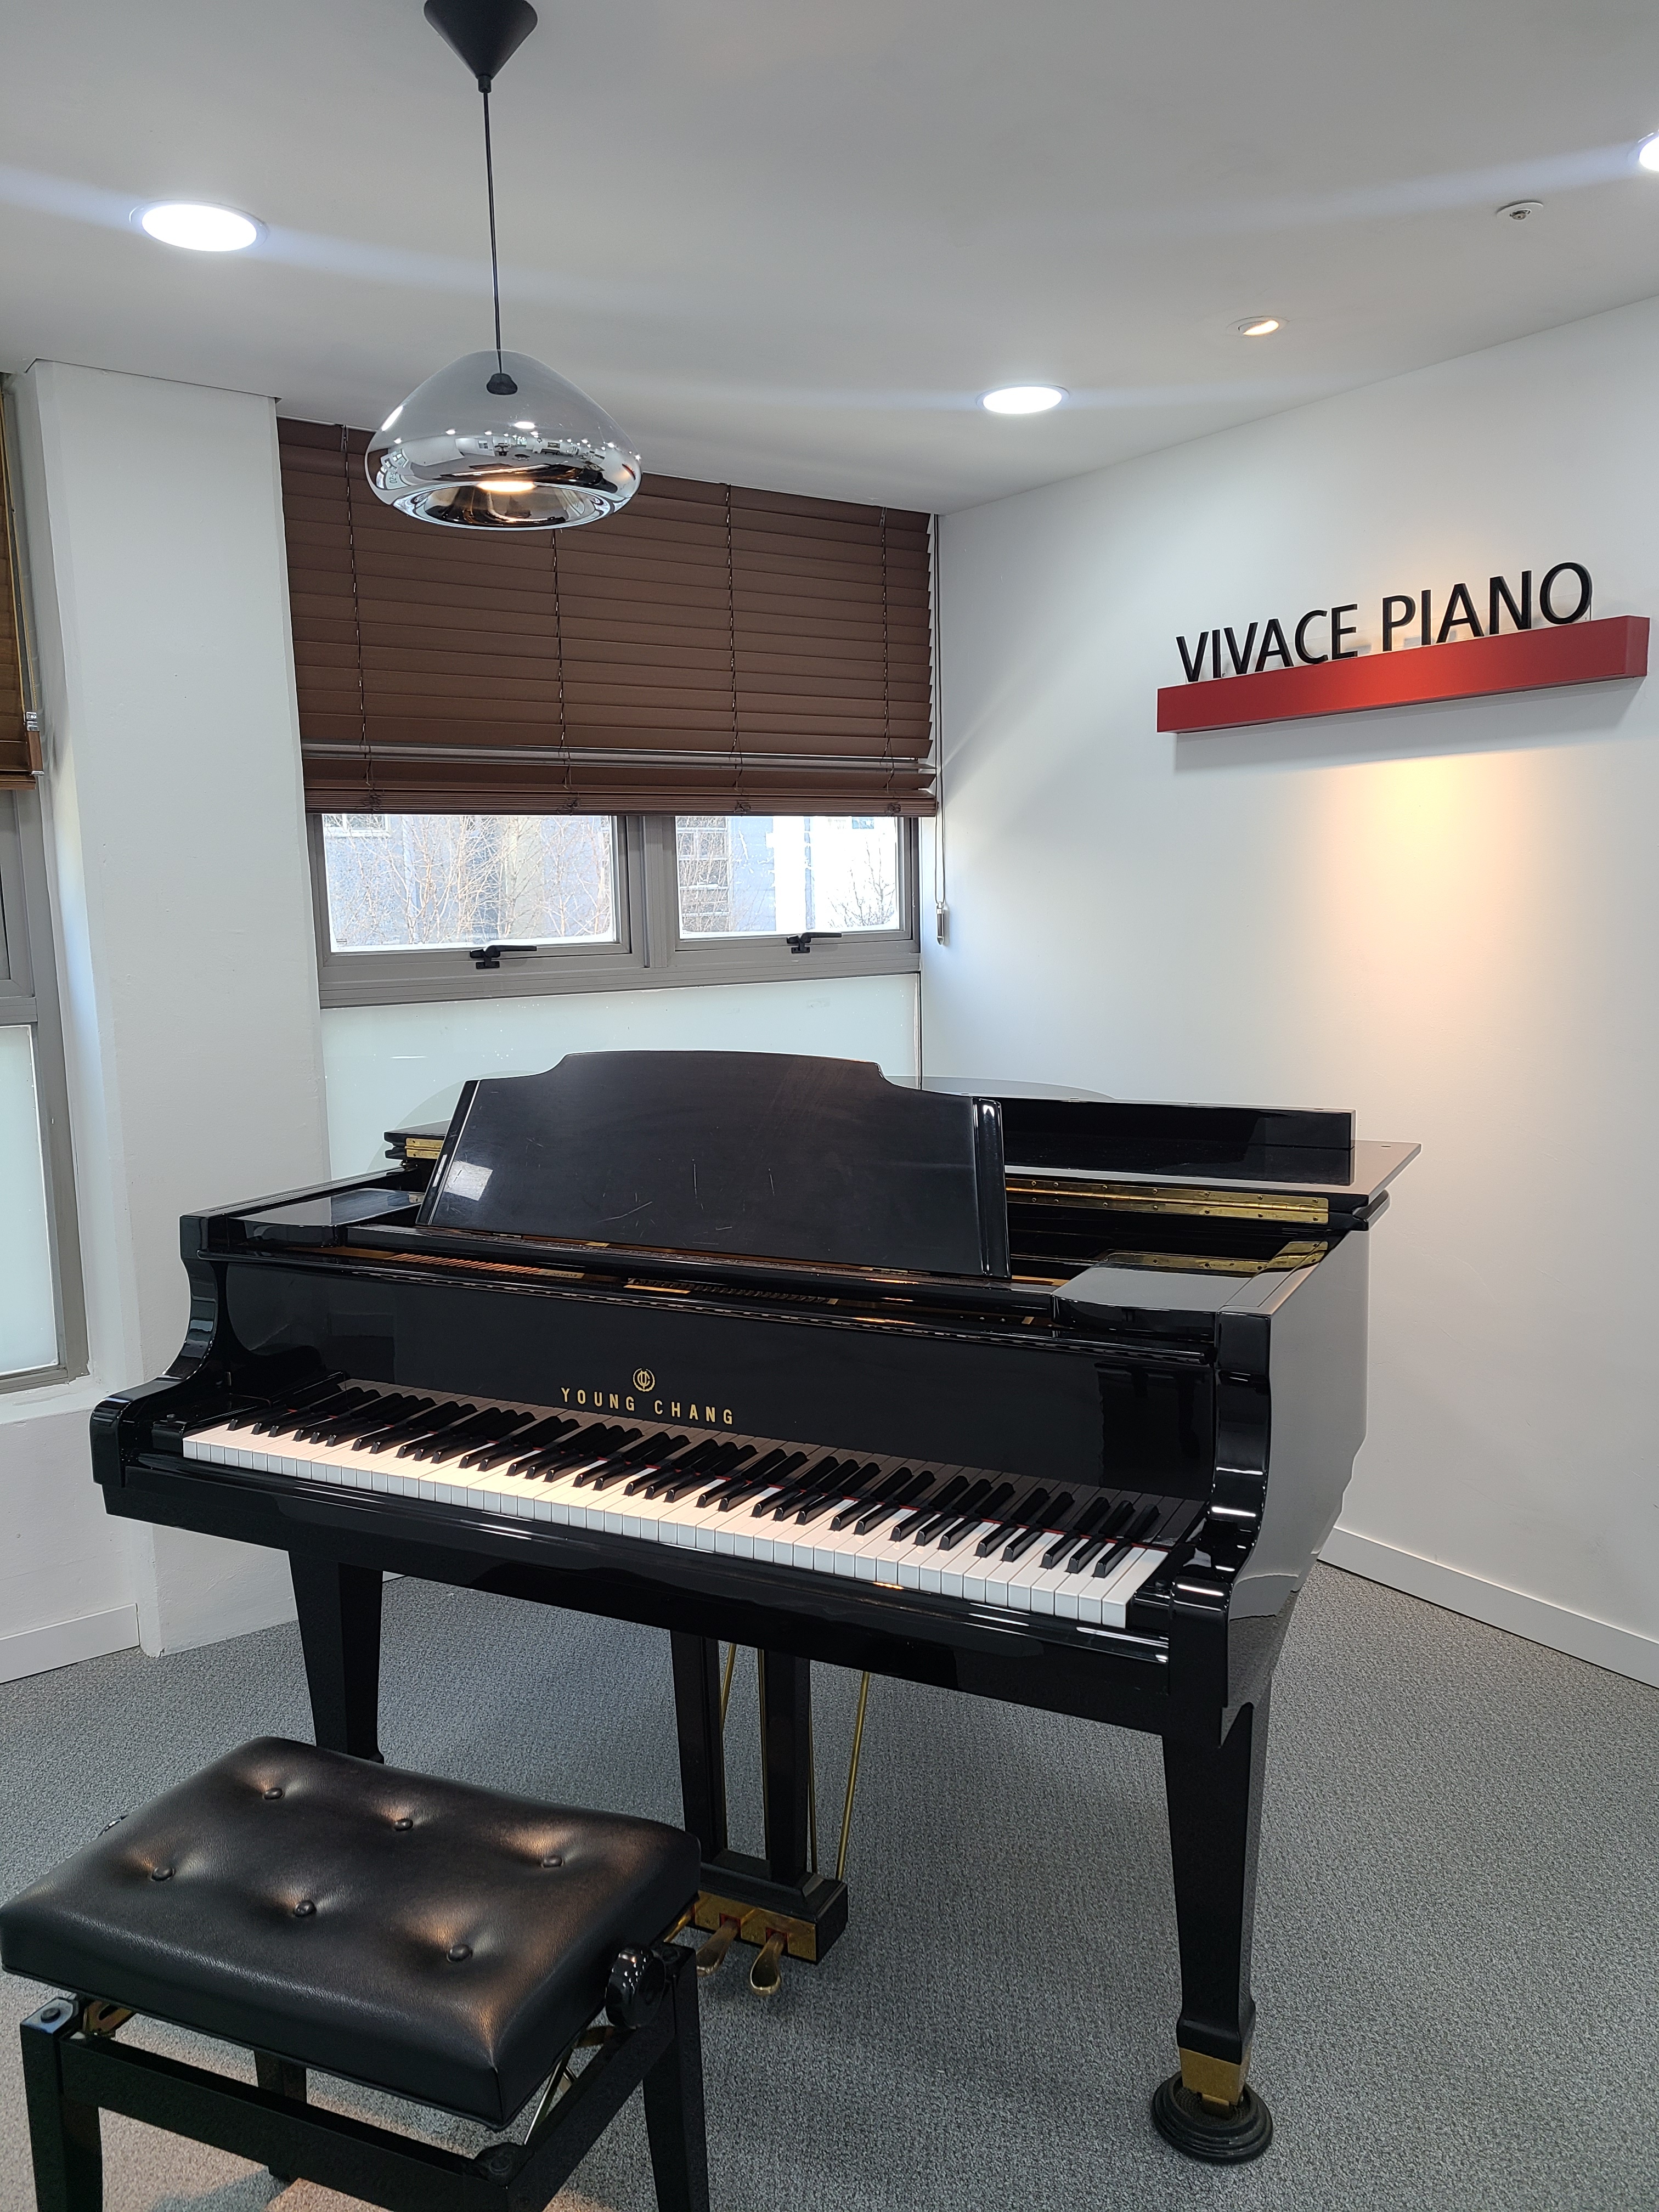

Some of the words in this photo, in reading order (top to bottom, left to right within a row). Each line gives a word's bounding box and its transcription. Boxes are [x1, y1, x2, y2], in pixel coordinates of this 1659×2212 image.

[1176, 603, 1358, 683] VIVACE
[1382, 562, 1593, 652] PIANO
[561, 1387, 635, 1412] YOUNG
[654, 1399, 733, 1425] CHANG
